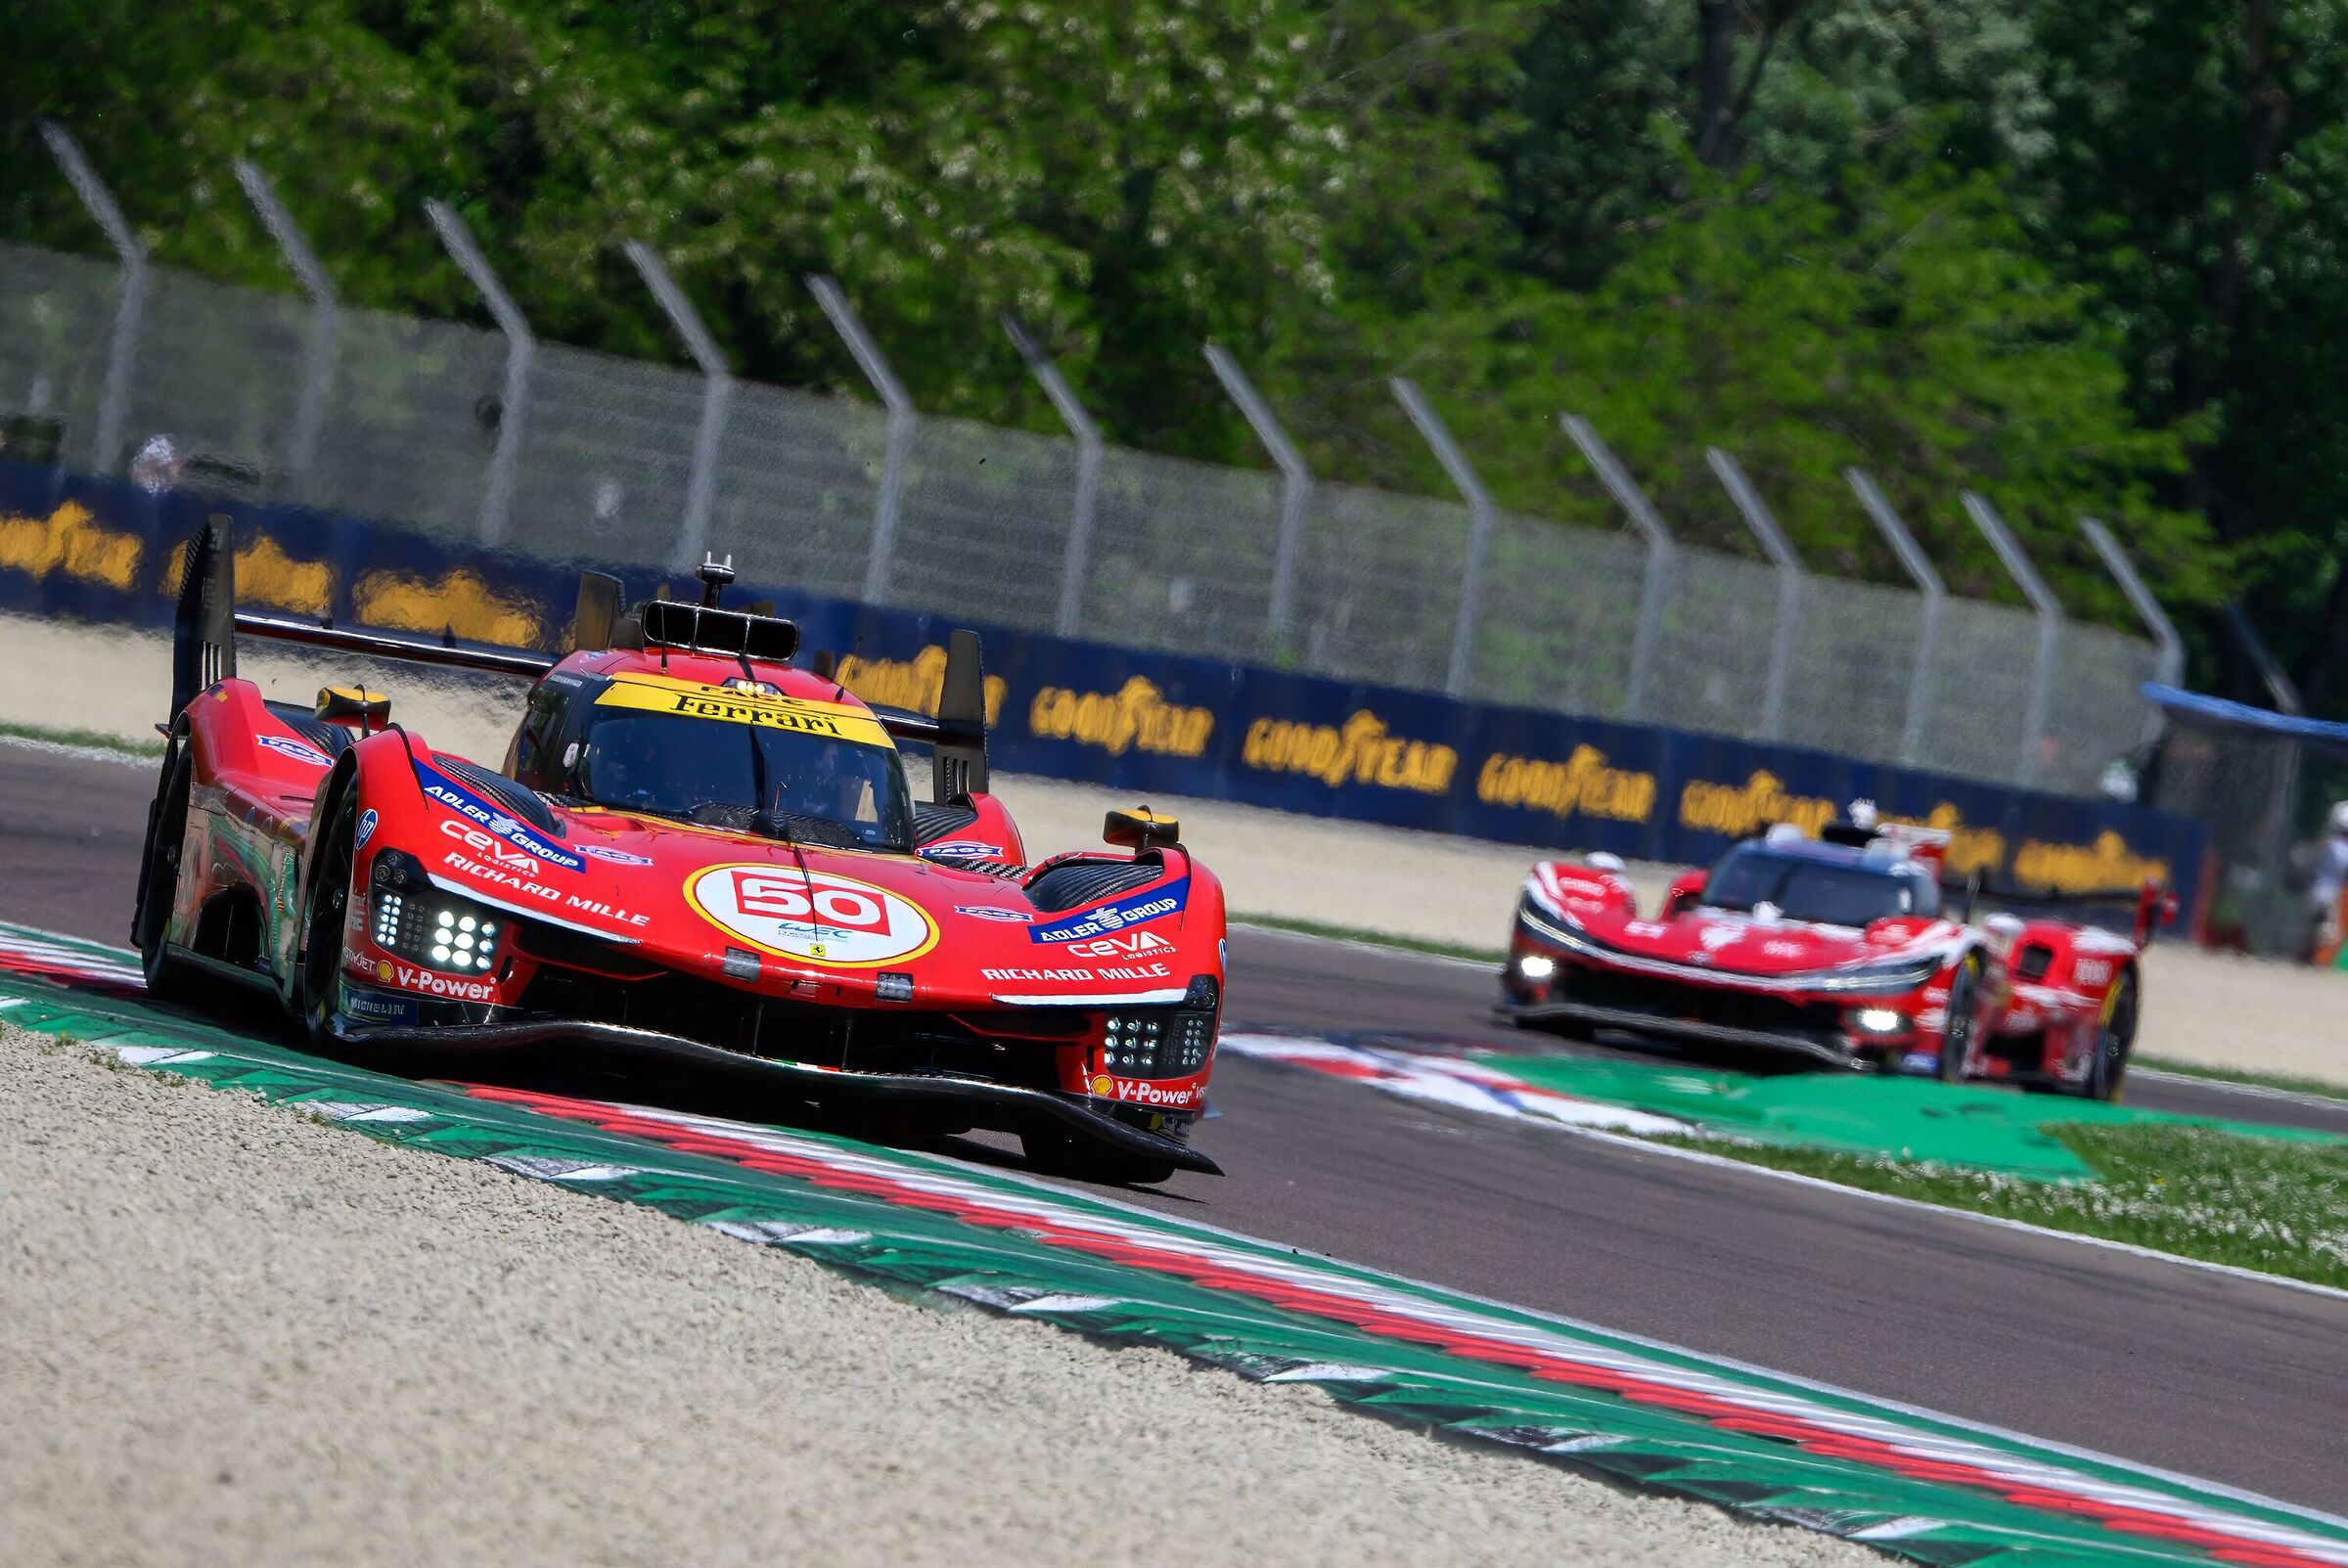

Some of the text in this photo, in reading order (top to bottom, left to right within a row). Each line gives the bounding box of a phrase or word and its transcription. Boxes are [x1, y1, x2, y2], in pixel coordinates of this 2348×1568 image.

[668, 693, 842, 736] Ferrari
[424, 785, 491, 823] ADLER
[510, 832, 579, 867] GROUP
[443, 852, 563, 901] RICHARD
[565, 895, 651, 926] MILLE
[743, 876, 881, 924] 50
[1040, 898, 1178, 942] ADLER GROUP
[980, 963, 1171, 981] RICHARD MILLE
